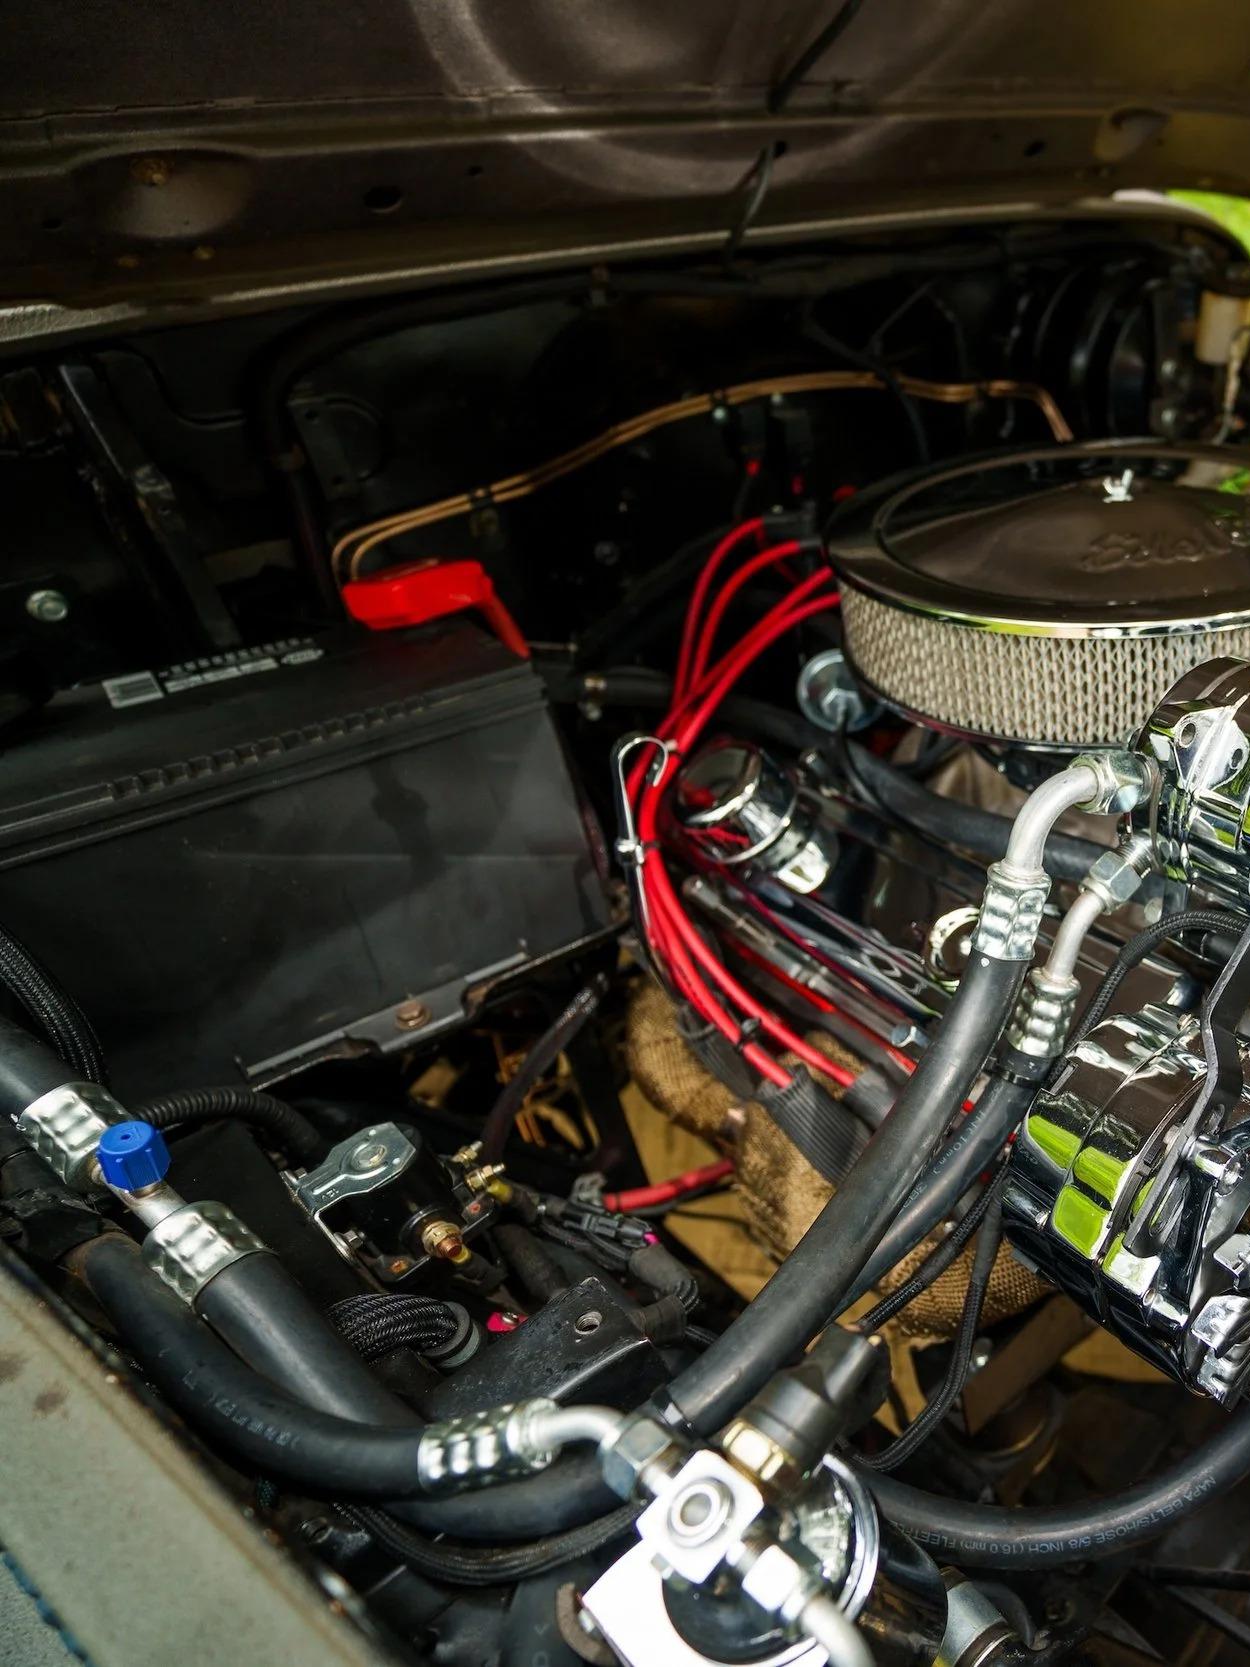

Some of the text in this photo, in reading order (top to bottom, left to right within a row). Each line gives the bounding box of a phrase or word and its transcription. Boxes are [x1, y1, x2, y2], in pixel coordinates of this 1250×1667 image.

[1183, 1474, 1217, 1502] NAPA
[1029, 1541, 1064, 1555] INCH
[1067, 1535, 1092, 1549] 5/8
